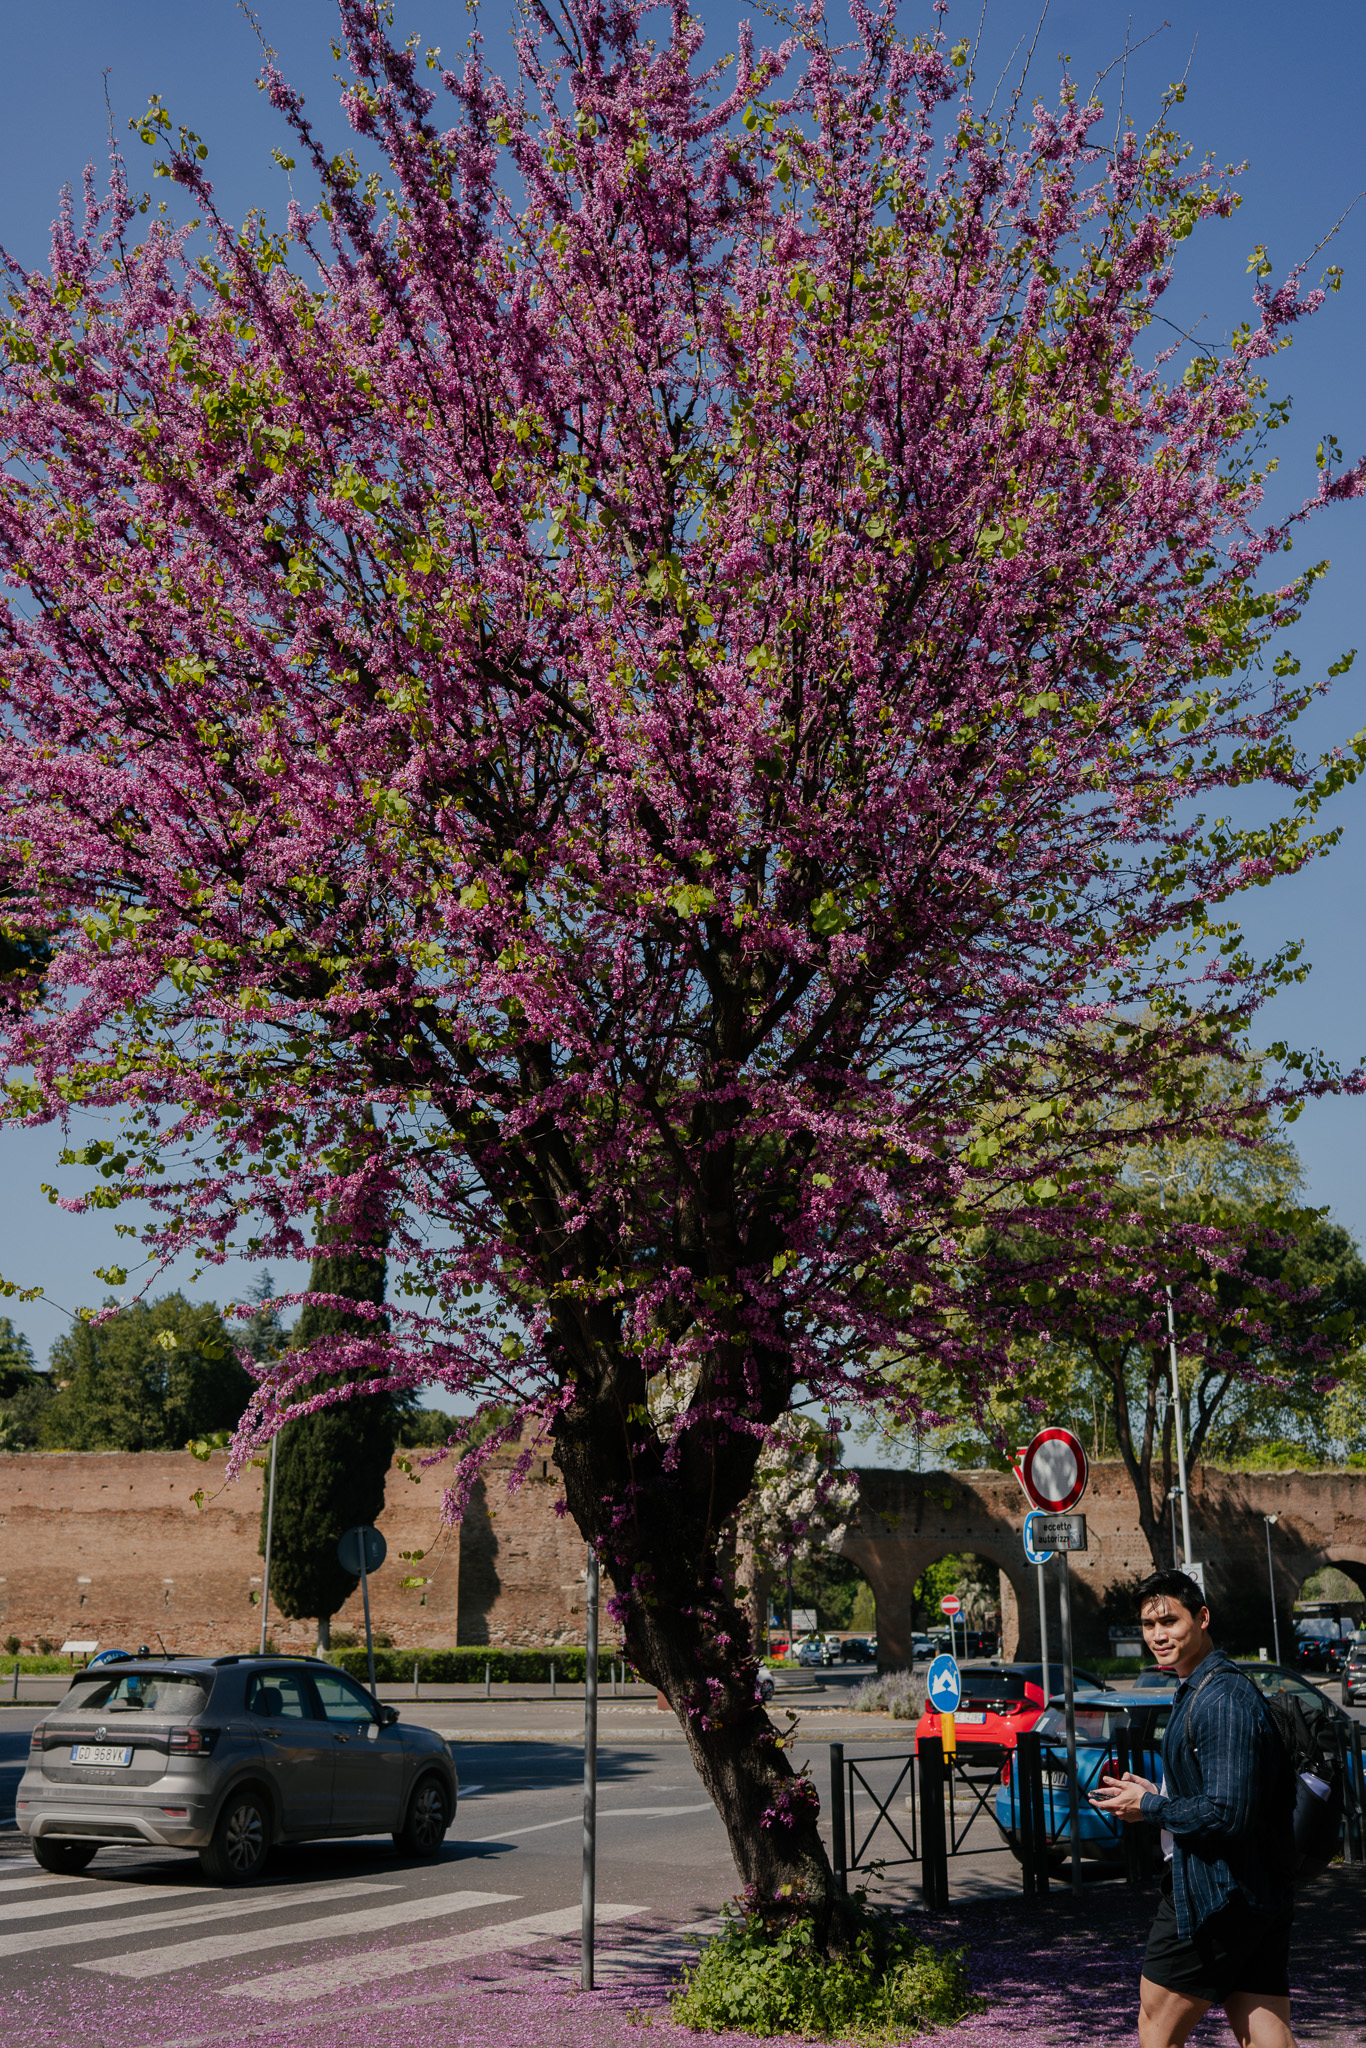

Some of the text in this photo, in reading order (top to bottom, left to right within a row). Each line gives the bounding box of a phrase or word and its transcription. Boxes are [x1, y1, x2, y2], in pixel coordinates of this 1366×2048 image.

[1043, 1522, 1072, 1531] eccetto
[78, 1747, 126, 1762] GD 968VK
